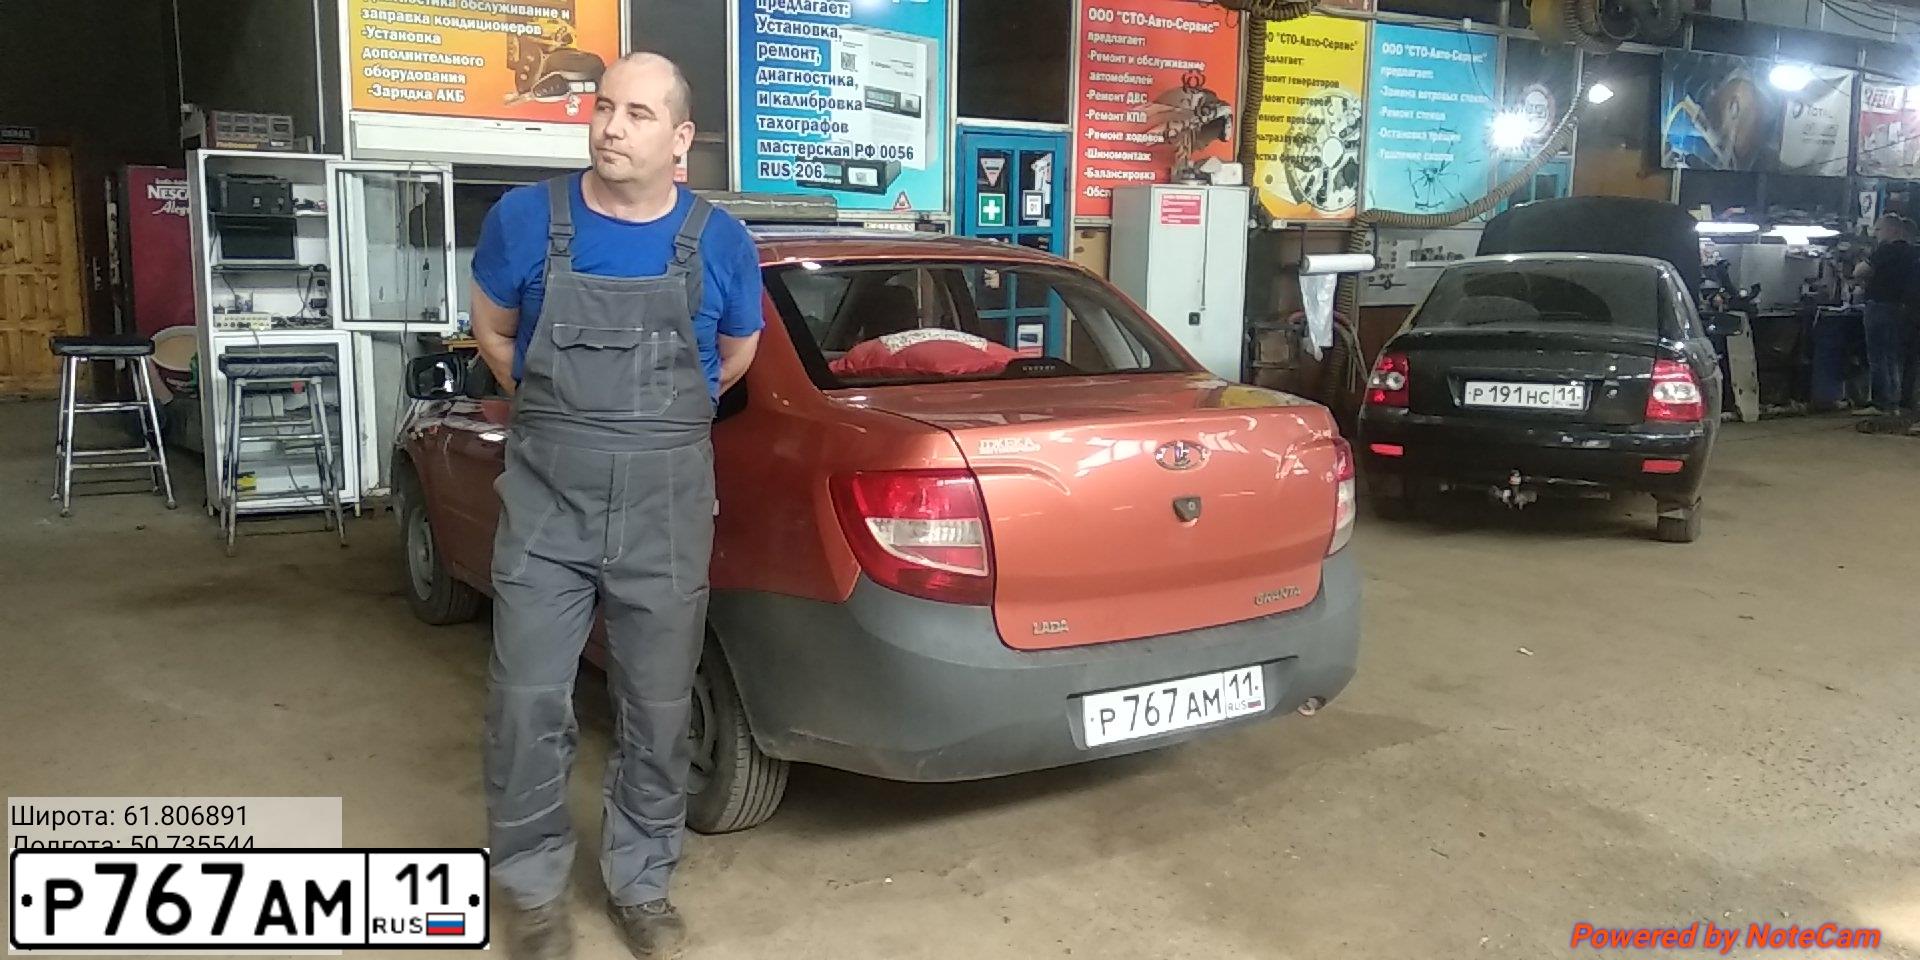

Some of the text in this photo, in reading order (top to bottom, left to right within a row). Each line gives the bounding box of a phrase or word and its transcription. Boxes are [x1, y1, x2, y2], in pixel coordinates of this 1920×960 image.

[362, 8, 542, 36] заправка кондиционеров
[561, 8, 570, 20] и
[1088, 7, 1220, 33] ООО "СТО-Авто-Сервис"
[361, 26, 442, 46] -Установка
[757, 15, 843, 41] Установка,
[1087, 31, 1146, 47] предлагает:
[362, 47, 484, 67] дополнительного
[758, 44, 821, 64] ремонт,
[1128, 55, 1135, 64] и
[1136, 55, 1206, 71] обслуживание
[364, 65, 466, 85] оборудования
[758, 69, 860, 91] диагностика,
[1089, 71, 1153, 86] автомобилей
[368, 83, 466, 104] -Зарядка АКБ
[1086, 89, 1148, 105] -Ремонт ДВС
[759, 92, 862, 114] и калибровка
[1085, 108, 1148, 123] -Ремонт КПП
[758, 117, 849, 135] тахографов
[1085, 127, 1124, 140] -Ремонт
[760, 141, 914, 161] мастерская РФ 0056
[1084, 147, 1152, 161] -Шиномонтаж
[760, 161, 823, 179] RUS 206
[1557, 387, 1576, 401] 11
[1033, 619, 1069, 635] LADA
[1228, 671, 1253, 699] 11
[1228, 700, 1247, 711] RUS
